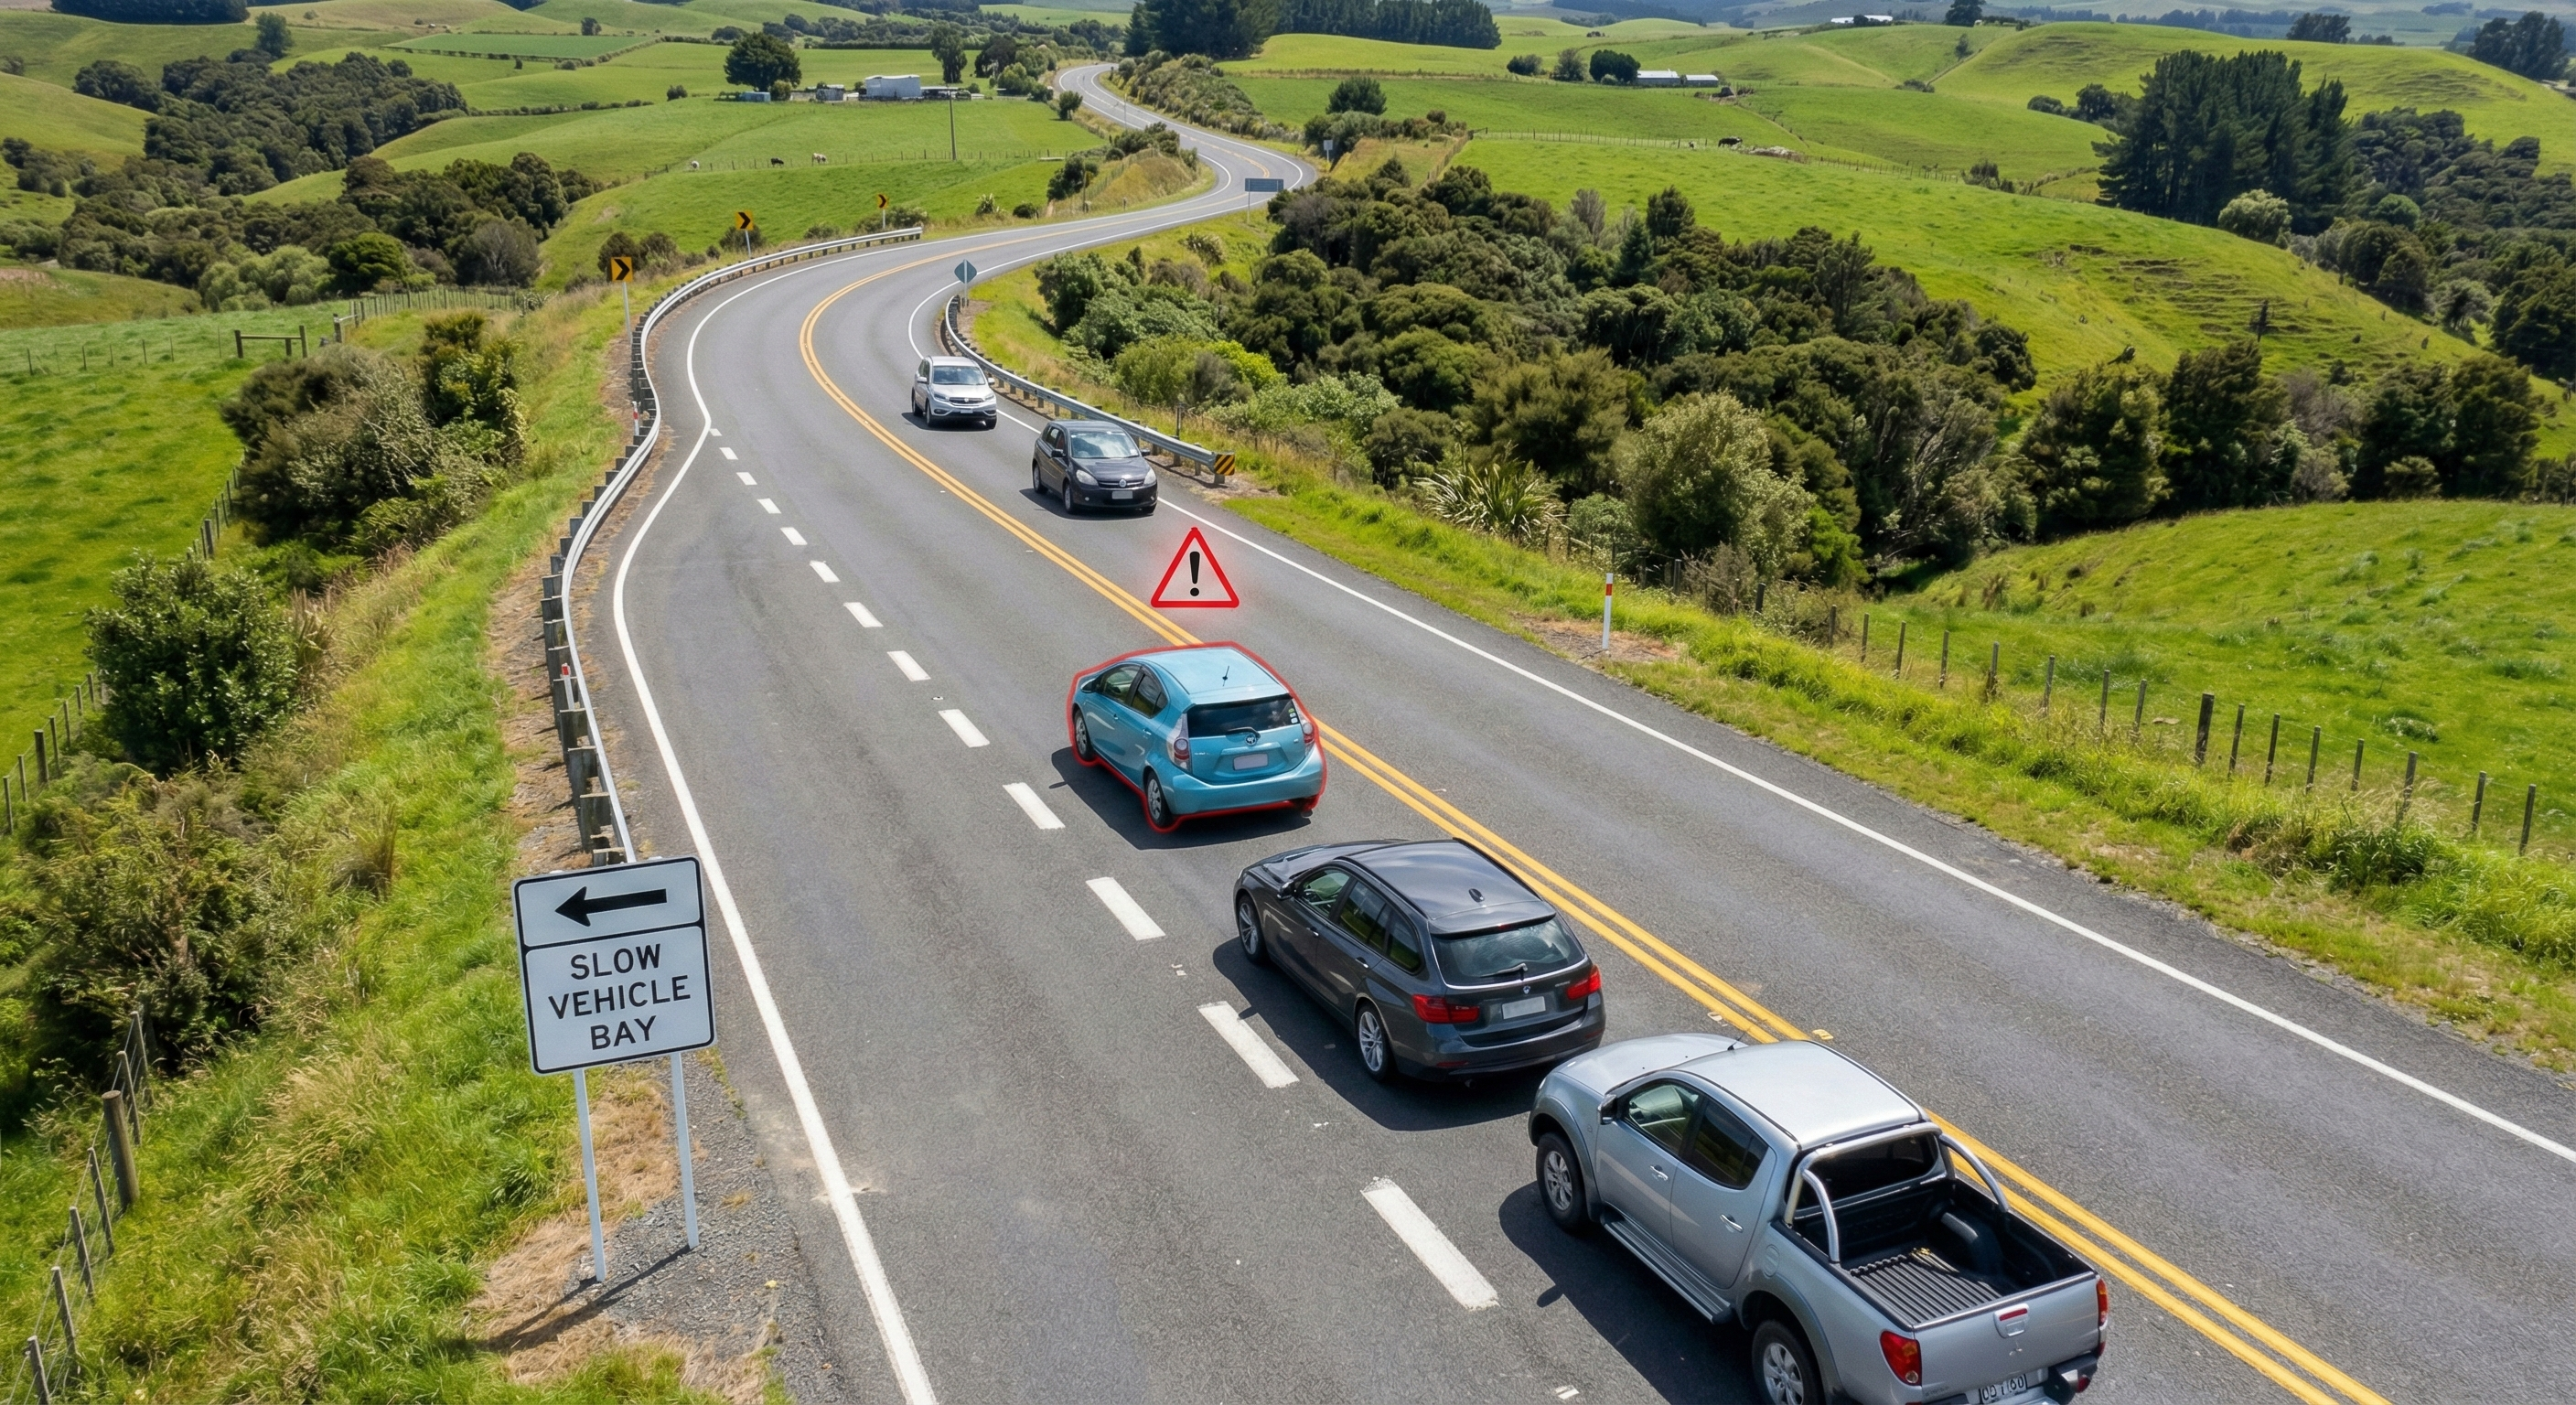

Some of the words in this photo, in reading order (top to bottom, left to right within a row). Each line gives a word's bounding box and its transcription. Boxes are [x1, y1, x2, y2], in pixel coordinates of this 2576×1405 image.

[570, 943, 661, 981] SLOW
[547, 974, 692, 1020] VEHICLE
[590, 1014, 657, 1051] BAY
